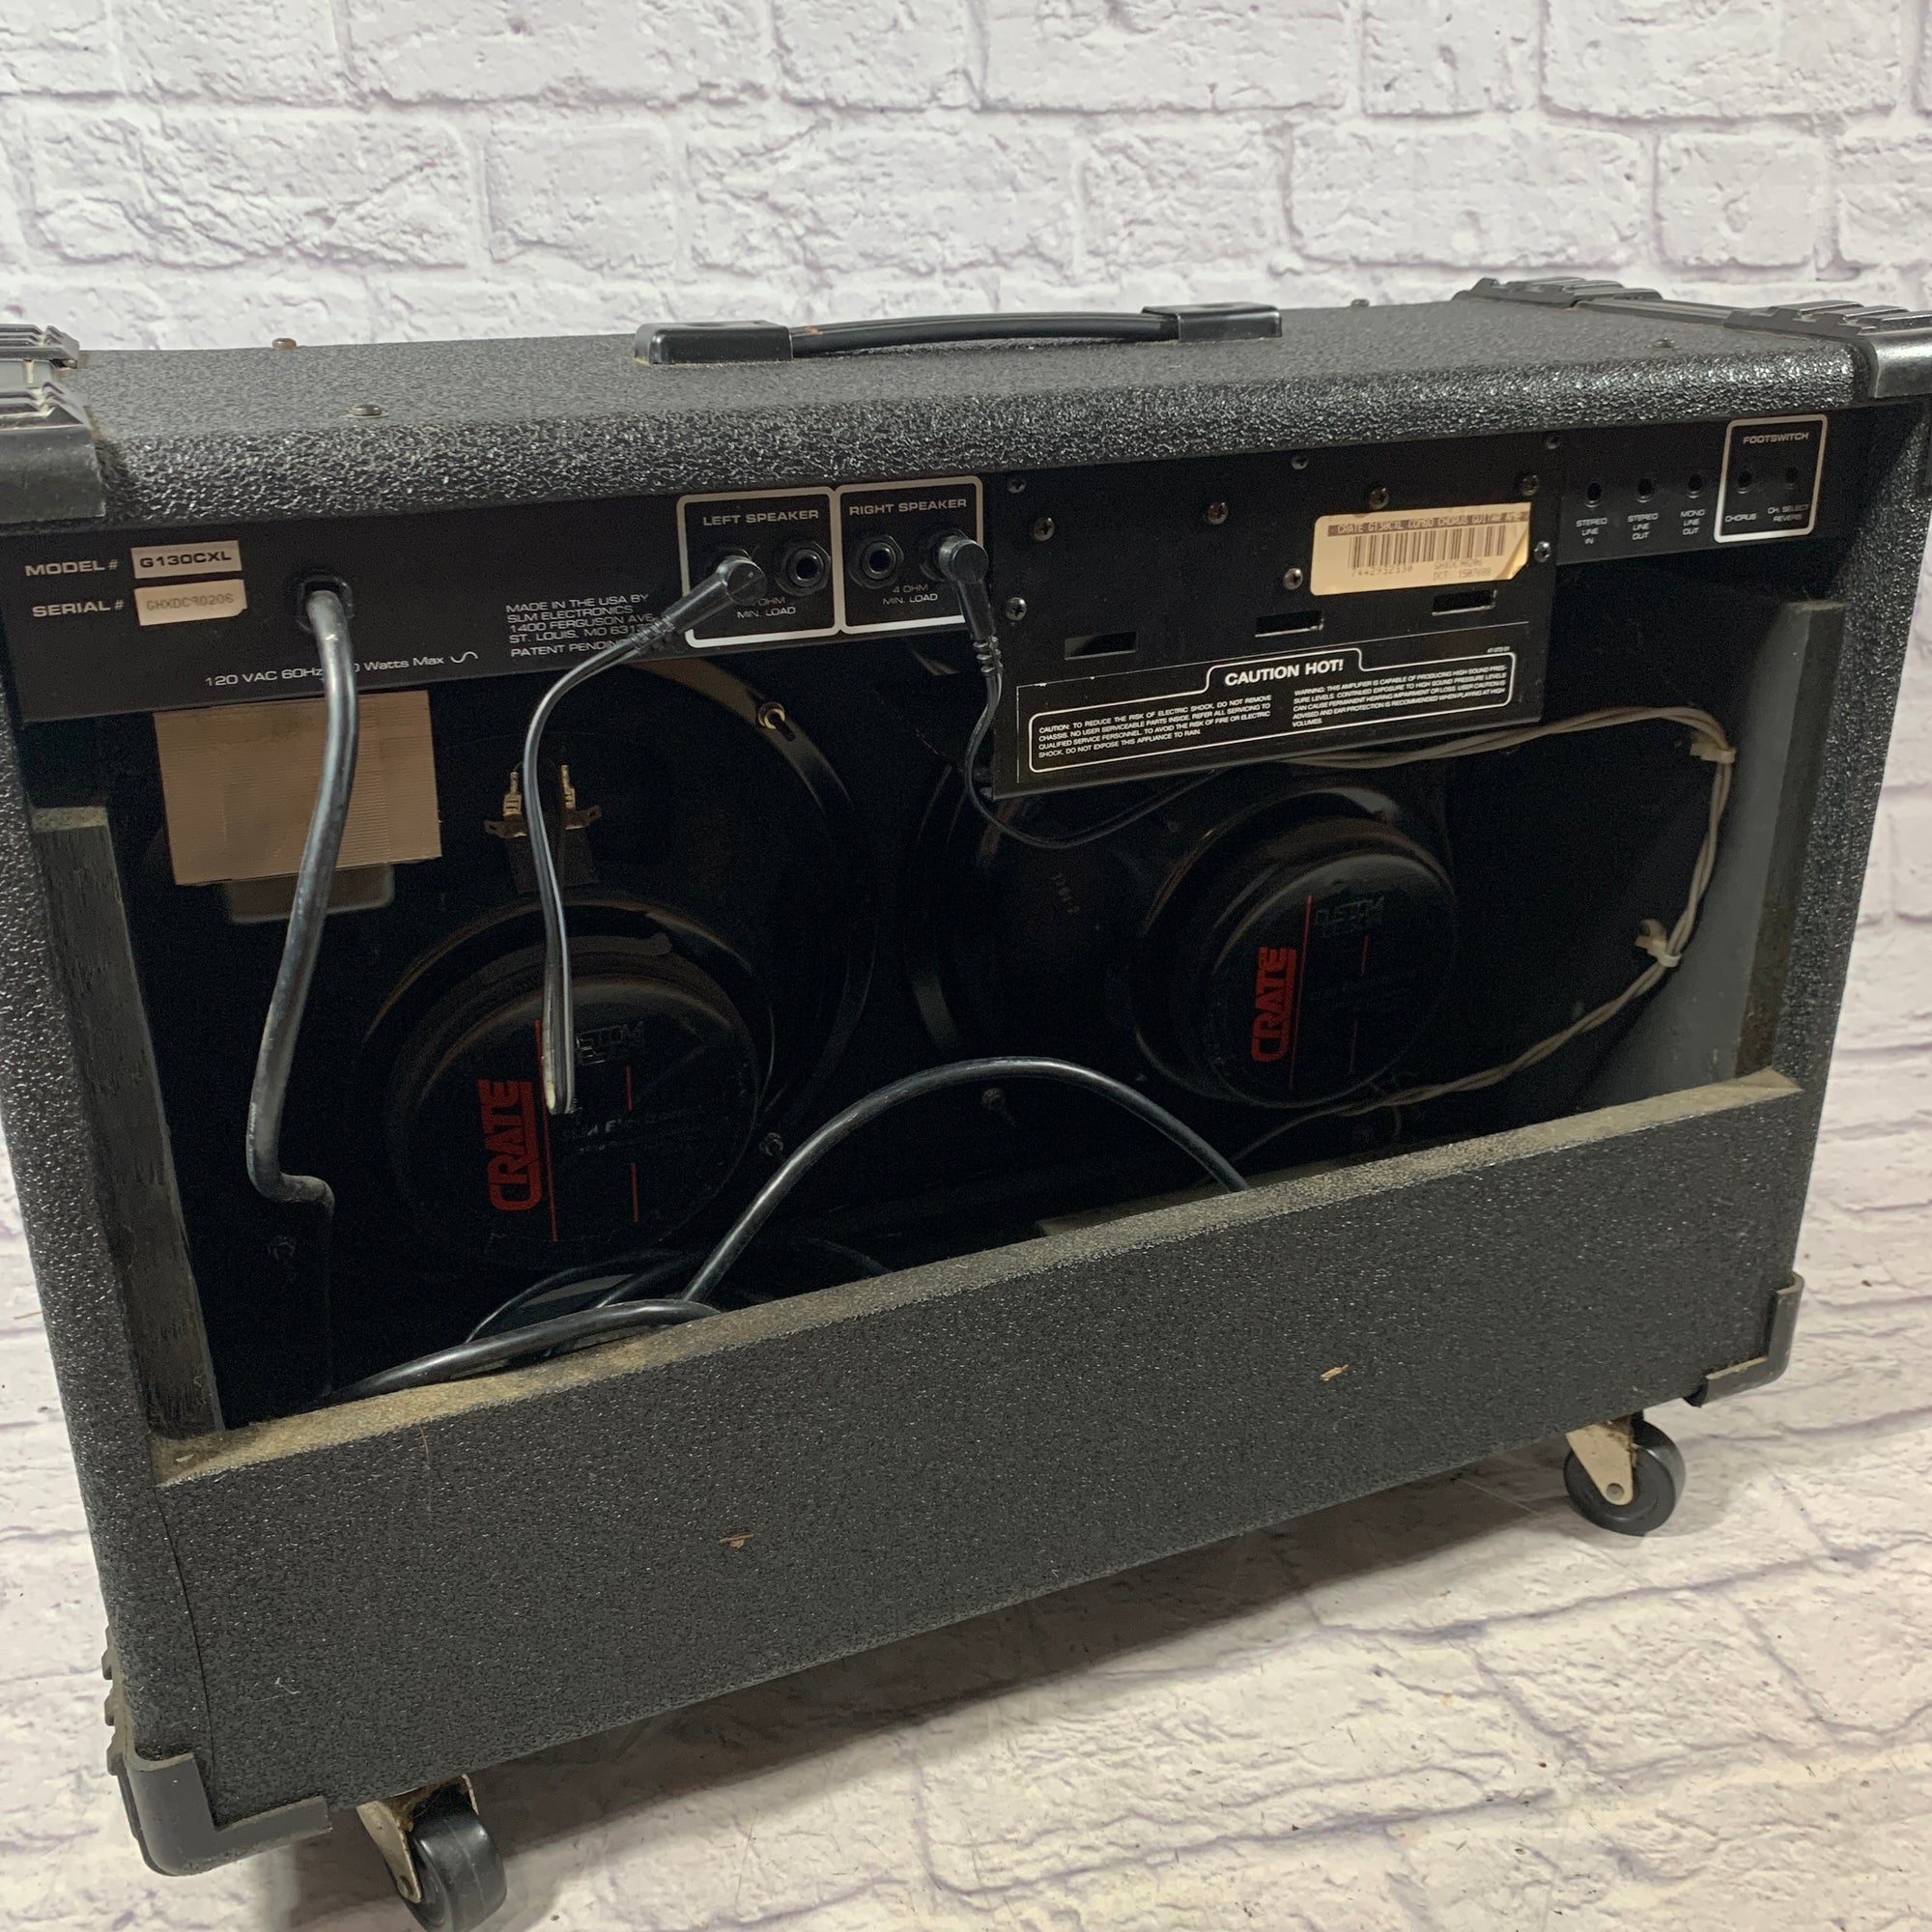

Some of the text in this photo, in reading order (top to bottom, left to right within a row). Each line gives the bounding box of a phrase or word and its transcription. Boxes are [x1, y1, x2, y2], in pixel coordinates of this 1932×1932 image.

[1743, 432, 1809, 444] FOOTSWITCH
[849, 497, 967, 516] RIGHT SPEAKER
[1680, 508, 1706, 518] MONO
[702, 509, 819, 526] LEFT SPEAKER
[1576, 517, 1608, 527] STEREO
[1627, 512, 1659, 523] STEREO
[1683, 518, 1700, 526] LINE
[1724, 513, 1757, 523] CHORUS
[1581, 527, 1600, 536] LINE
[1633, 523, 1650, 531] LINE
[1682, 526, 1700, 535] OUT
[1632, 531, 1650, 540] OUT
[139, 551, 232, 568] G130CXL
[902, 583, 929, 593] OHM
[505, 593, 650, 612] MADE IN THE USA BY
[757, 596, 785, 606] OHM
[882, 593, 938, 607] MIN. LOAD
[507, 605, 634, 624] SLM ELECTRONICS
[736, 606, 796, 619] MIN. LOAD
[509, 622, 547, 634] 1400
[549, 615, 624, 630] FERGUSON
[509, 634, 531, 643] ST.
[583, 627, 608, 638] MO
[510, 639, 621, 657] PATENT PENDIN
[363, 659, 410, 671] Watts
[412, 656, 444, 667] Max
[205, 667, 324, 687] 120 VAC 60Hz
[1224, 659, 1344, 686] CAUTION HOT!
[1038, 724, 1070, 734] CAUTION:
[1084, 718, 1112, 727] REDUCE
[1157, 706, 1188, 717] ELECTRIC
[1244, 695, 1272, 704] REMOVE
[1082, 727, 1100, 736] USER
[1101, 721, 1145, 733] SERVICEABLE
[1146, 718, 1168, 726] PARTS
[1191, 711, 1213, 720] REFER
[1227, 704, 1261, 715] SERVICING
[1038, 739, 1072, 751] QUALIFIED
[1073, 735, 1101, 746] SERVICE
[1153, 724, 1175, 733] AVOID
[1189, 720, 1204, 728] RISK
[1240, 710, 1271, 721] ELECTRIC
[1093, 740, 1120, 751] EXPOSE
[1136, 732, 1173, 744] APPLIANCE
[1250, 945, 1297, 1063] CRATE
[477, 1079, 542, 1210] CRATE
